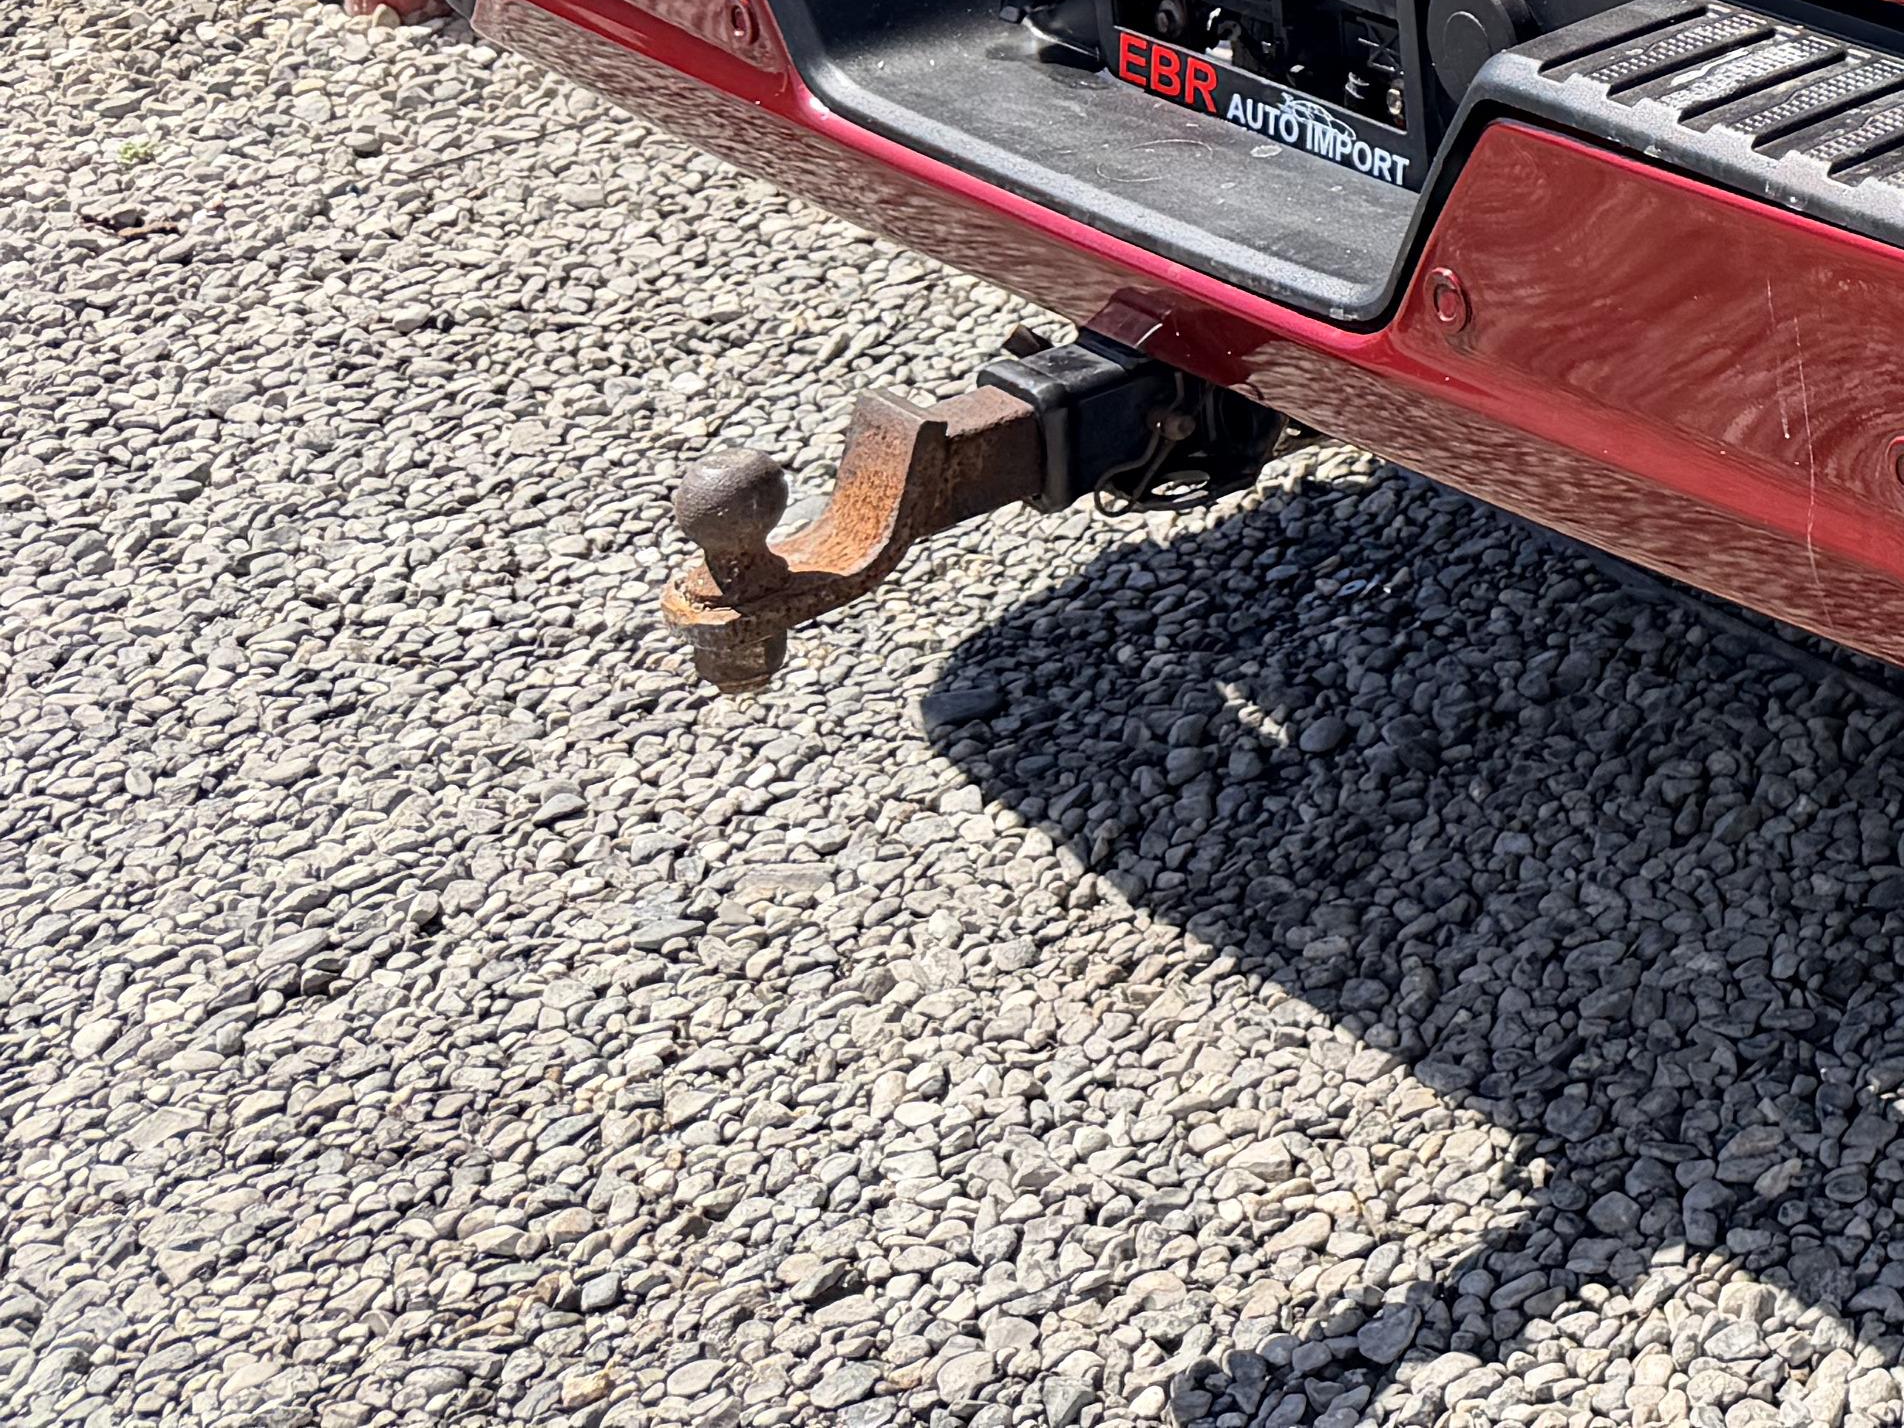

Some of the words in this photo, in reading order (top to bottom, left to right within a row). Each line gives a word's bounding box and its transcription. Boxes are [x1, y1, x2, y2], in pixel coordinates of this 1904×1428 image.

[1118, 31, 1219, 114] EBR
[1226, 93, 1300, 144] AUTO
[1306, 121, 1410, 186] IMPORT
